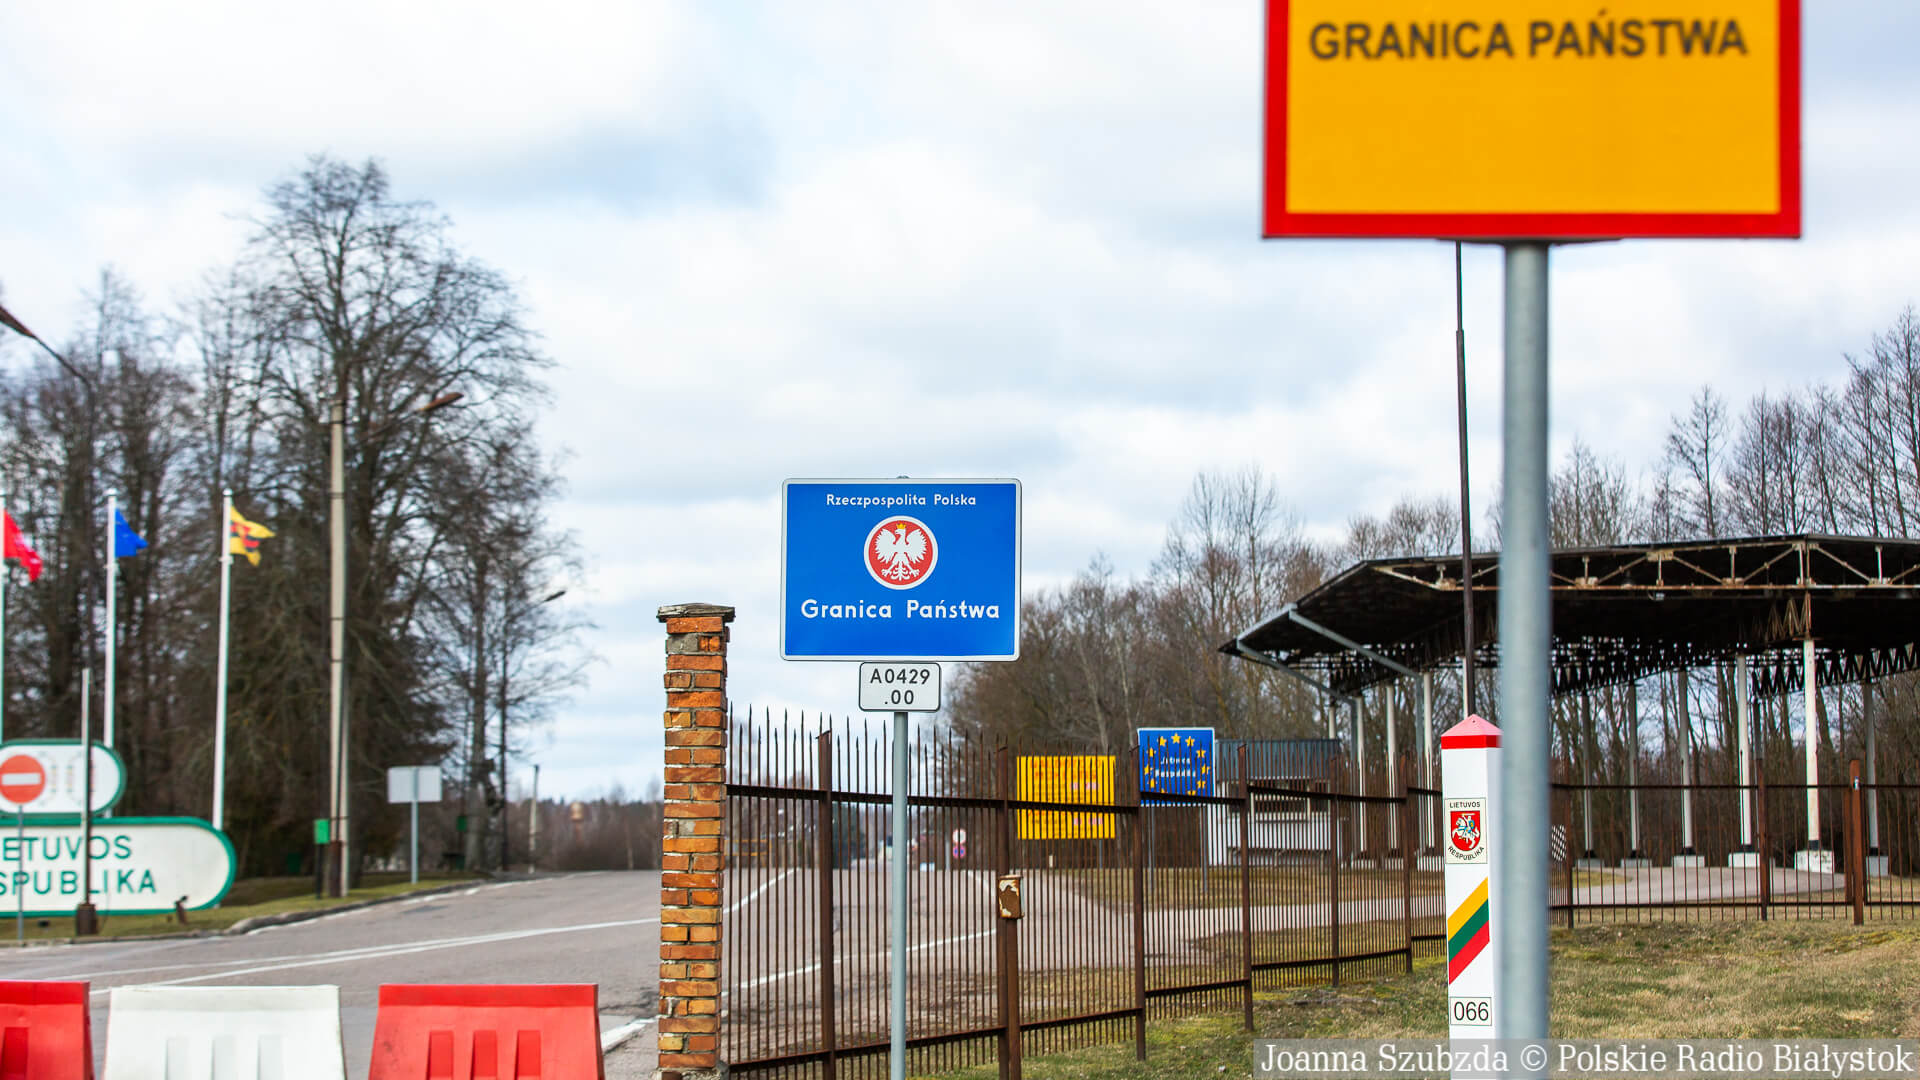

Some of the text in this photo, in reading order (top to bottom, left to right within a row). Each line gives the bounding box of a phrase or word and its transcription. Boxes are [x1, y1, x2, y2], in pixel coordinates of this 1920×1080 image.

[1308, 8, 1749, 60] GRANICA PAŃSTWA
[826, 493, 976, 509] Rzeczpospolita Polska
[800, 598, 1000, 619] Granica Państwa
[870, 668, 931, 685] A0429
[884, 689, 915, 705] .00
[1449, 801, 1481, 809] LIETUVOS
[1448, 845, 1485, 861] RESPUBLIKA
[1453, 1001, 1489, 1022] 066
